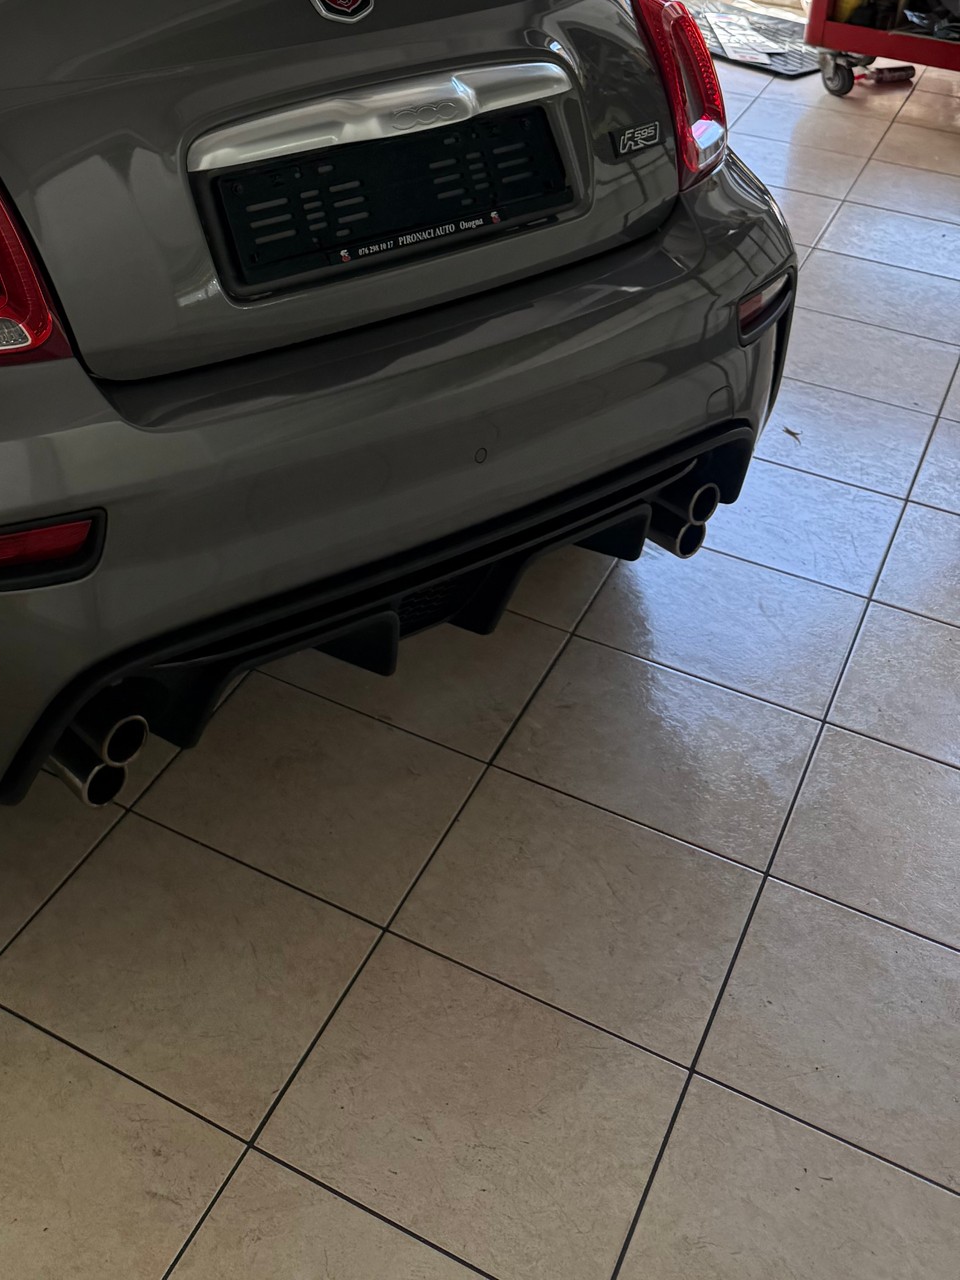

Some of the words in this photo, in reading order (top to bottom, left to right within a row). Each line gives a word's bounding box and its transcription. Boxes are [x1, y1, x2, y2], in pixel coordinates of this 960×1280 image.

[398, 228, 435, 246] PIRONACI
[435, 223, 456, 237] AUTO
[459, 218, 484, 230] Osogna
